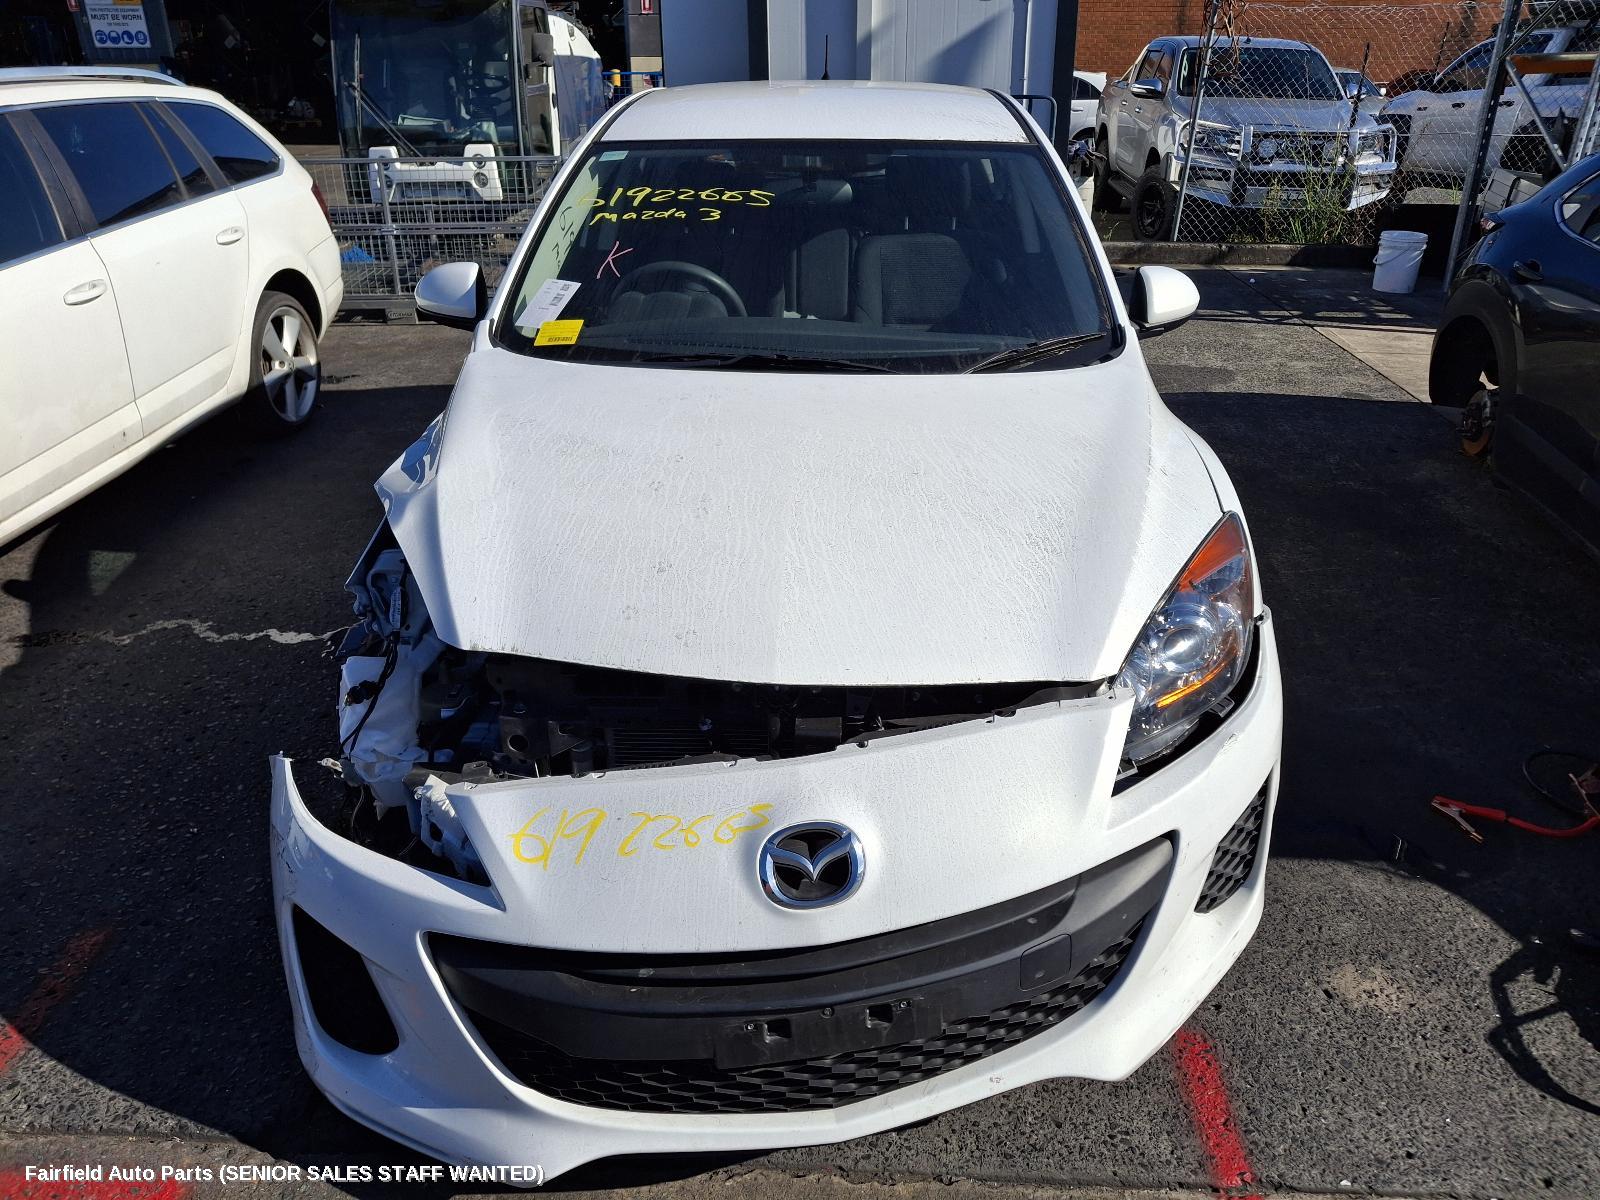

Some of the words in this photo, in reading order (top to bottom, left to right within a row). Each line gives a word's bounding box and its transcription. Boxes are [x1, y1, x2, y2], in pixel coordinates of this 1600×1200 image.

[90, 13, 109, 21] MUST
[699, 208, 722, 221] 3
[596, 241, 634, 279] K
